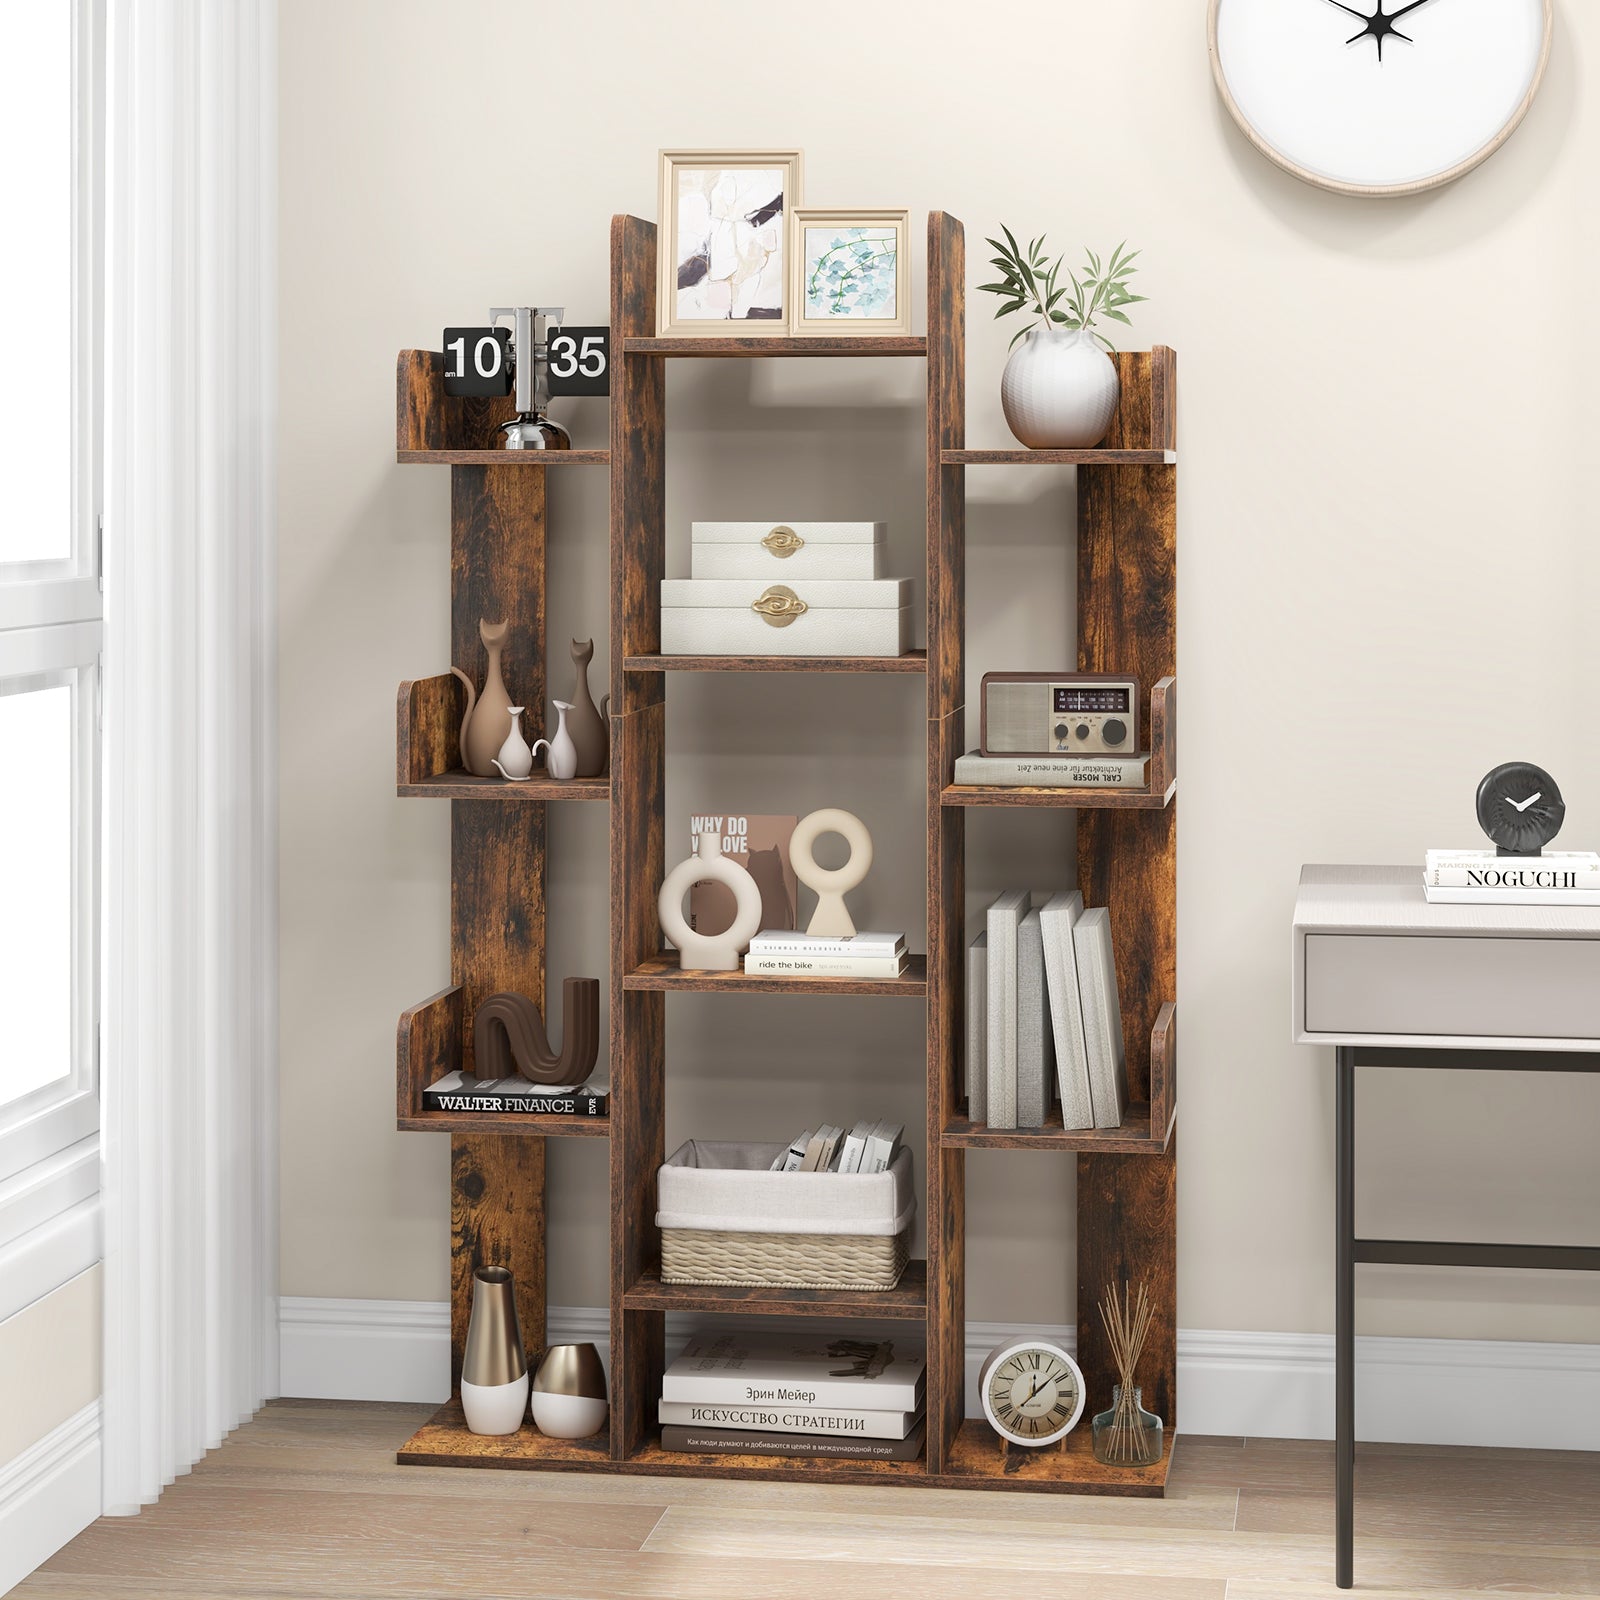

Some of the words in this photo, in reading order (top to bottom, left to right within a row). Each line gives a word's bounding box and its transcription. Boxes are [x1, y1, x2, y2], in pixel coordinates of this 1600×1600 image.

[447, 336, 502, 378] 10
[550, 336, 607, 378] 35
[1017, 764, 1032, 773] Zeit
[1033, 764, 1051, 772] neue
[1052, 765, 1068, 773] eine
[1070, 765, 1080, 774] für
[1082, 765, 1122, 774] Architektur
[1073, 773, 1099, 782] MOSER
[1102, 774, 1122, 782] CARL
[691, 816, 723, 834] WHY
[728, 817, 748, 835] DO
[720, 836, 748, 853] OVE
[1467, 869, 1577, 888] NOGUCHI
[759, 961, 776, 969] ride
[778, 961, 793, 969] the
[794, 962, 813, 970] bike
[437, 1096, 503, 1111] WALTER
[504, 1098, 575, 1113] FINANCE
[588, 1098, 597, 1115] EVR
[746, 1387, 775, 1401] Эрин
[777, 1388, 816, 1403] Мейер
[691, 1408, 779, 1426] ИСКУССТВО
[783, 1414, 865, 1431] СТРАТЕГИИ
[687, 1438, 699, 1446] Как
[750, 1441, 790, 1449] добиваются
[818, 1445, 872, 1453] международной
[873, 1447, 893, 1455] среде
